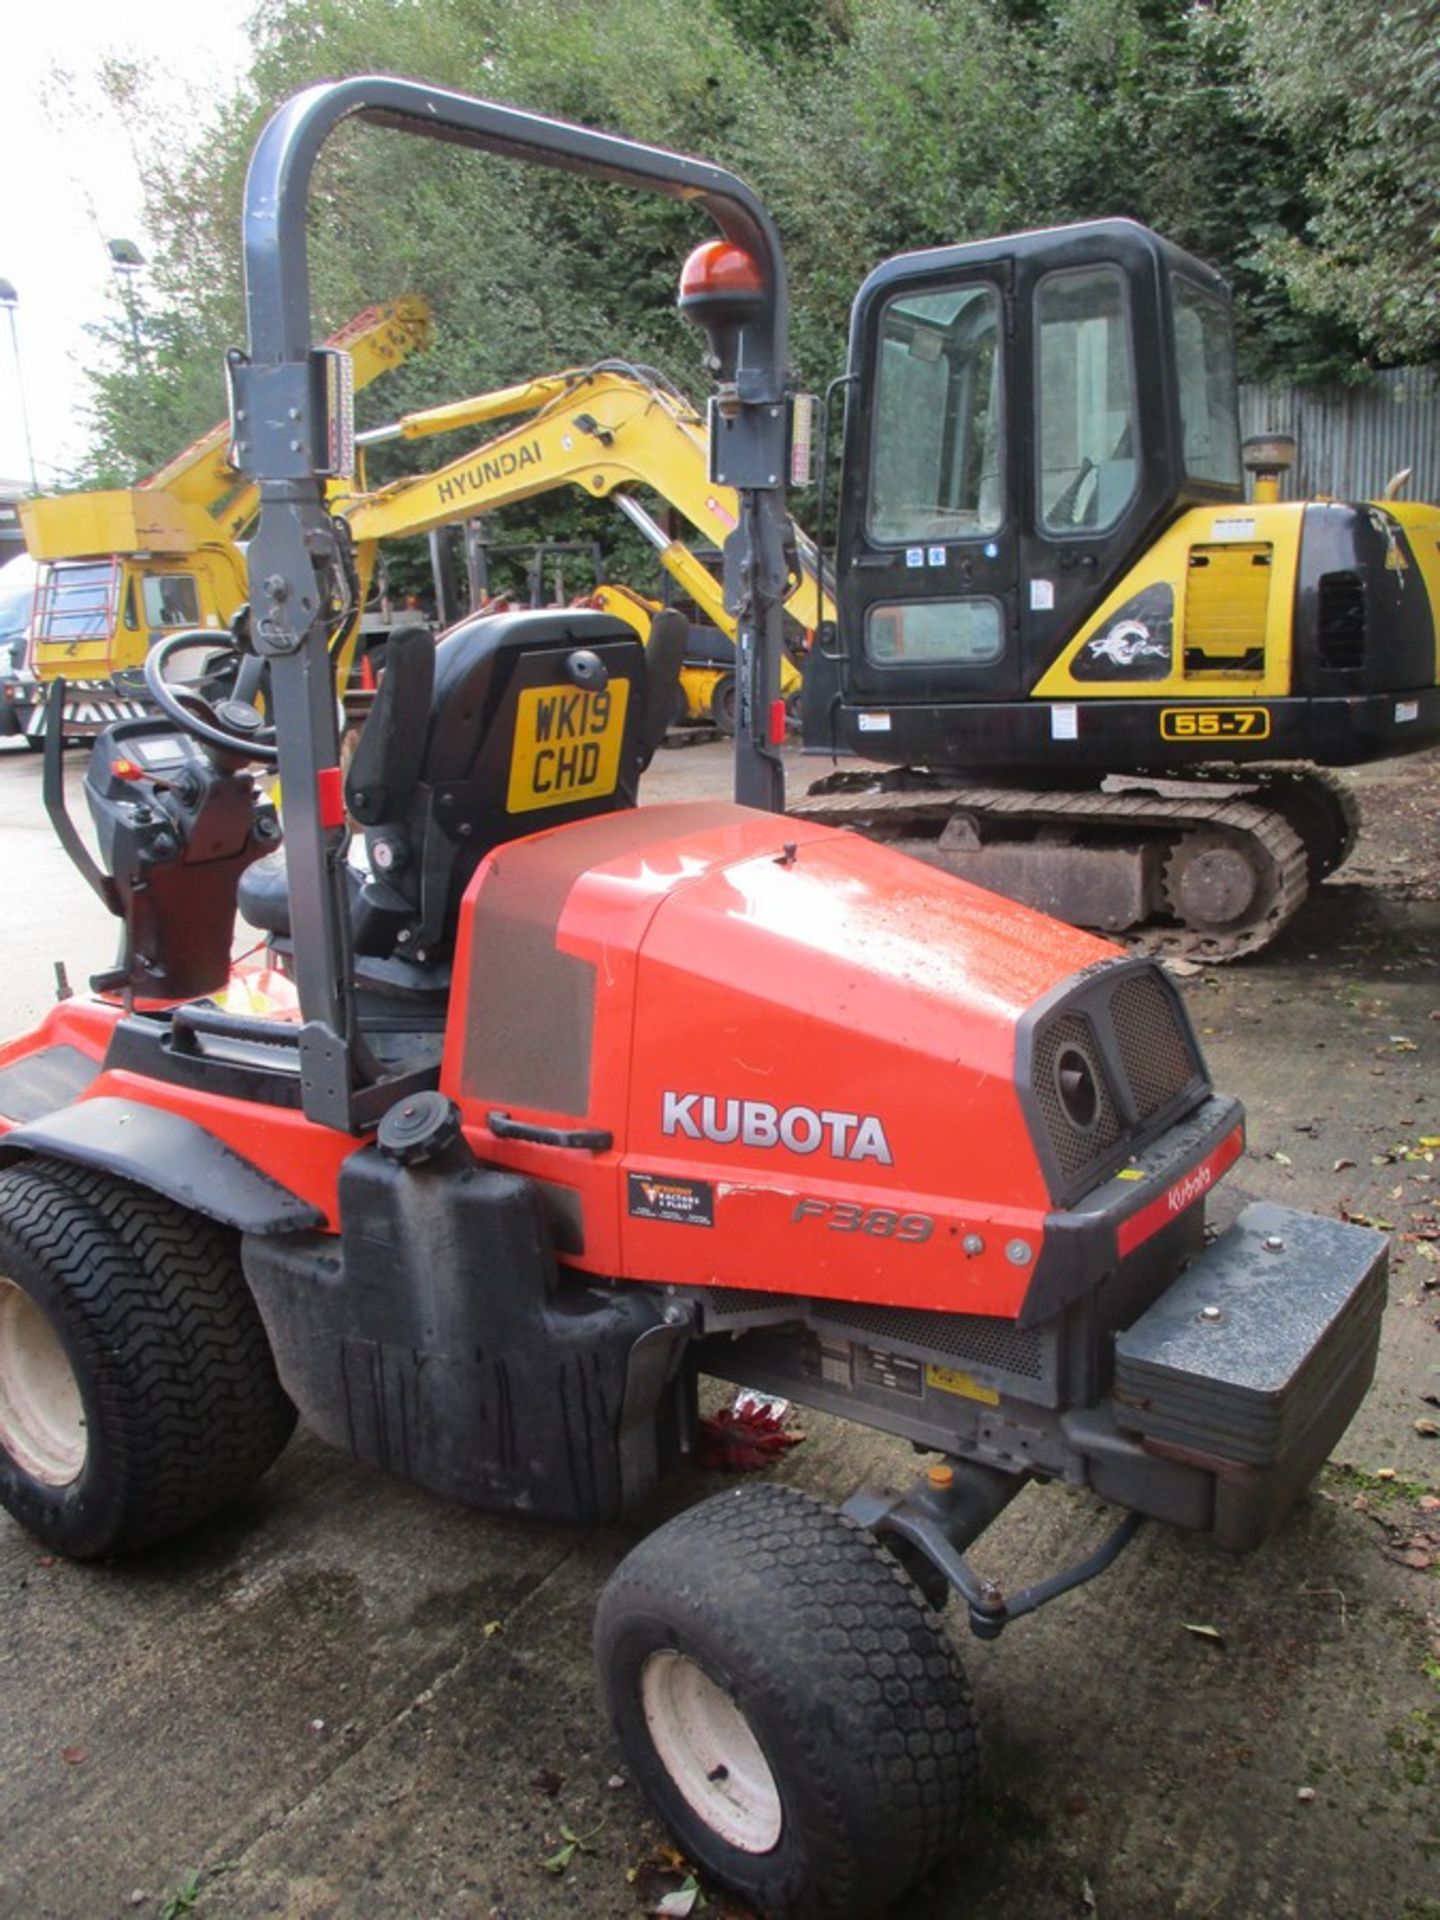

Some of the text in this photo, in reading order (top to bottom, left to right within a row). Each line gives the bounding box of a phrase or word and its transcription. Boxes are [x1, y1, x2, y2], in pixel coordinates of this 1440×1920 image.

[437, 440, 542, 503] HYUNDAI
[535, 691, 611, 743] WK19
[1175, 714, 1256, 734] 55-7
[532, 742, 601, 794] CHD
[662, 1091, 894, 1165] KUBOTA
[1168, 1167, 1211, 1211] Kubota
[792, 1199, 934, 1243] F389
